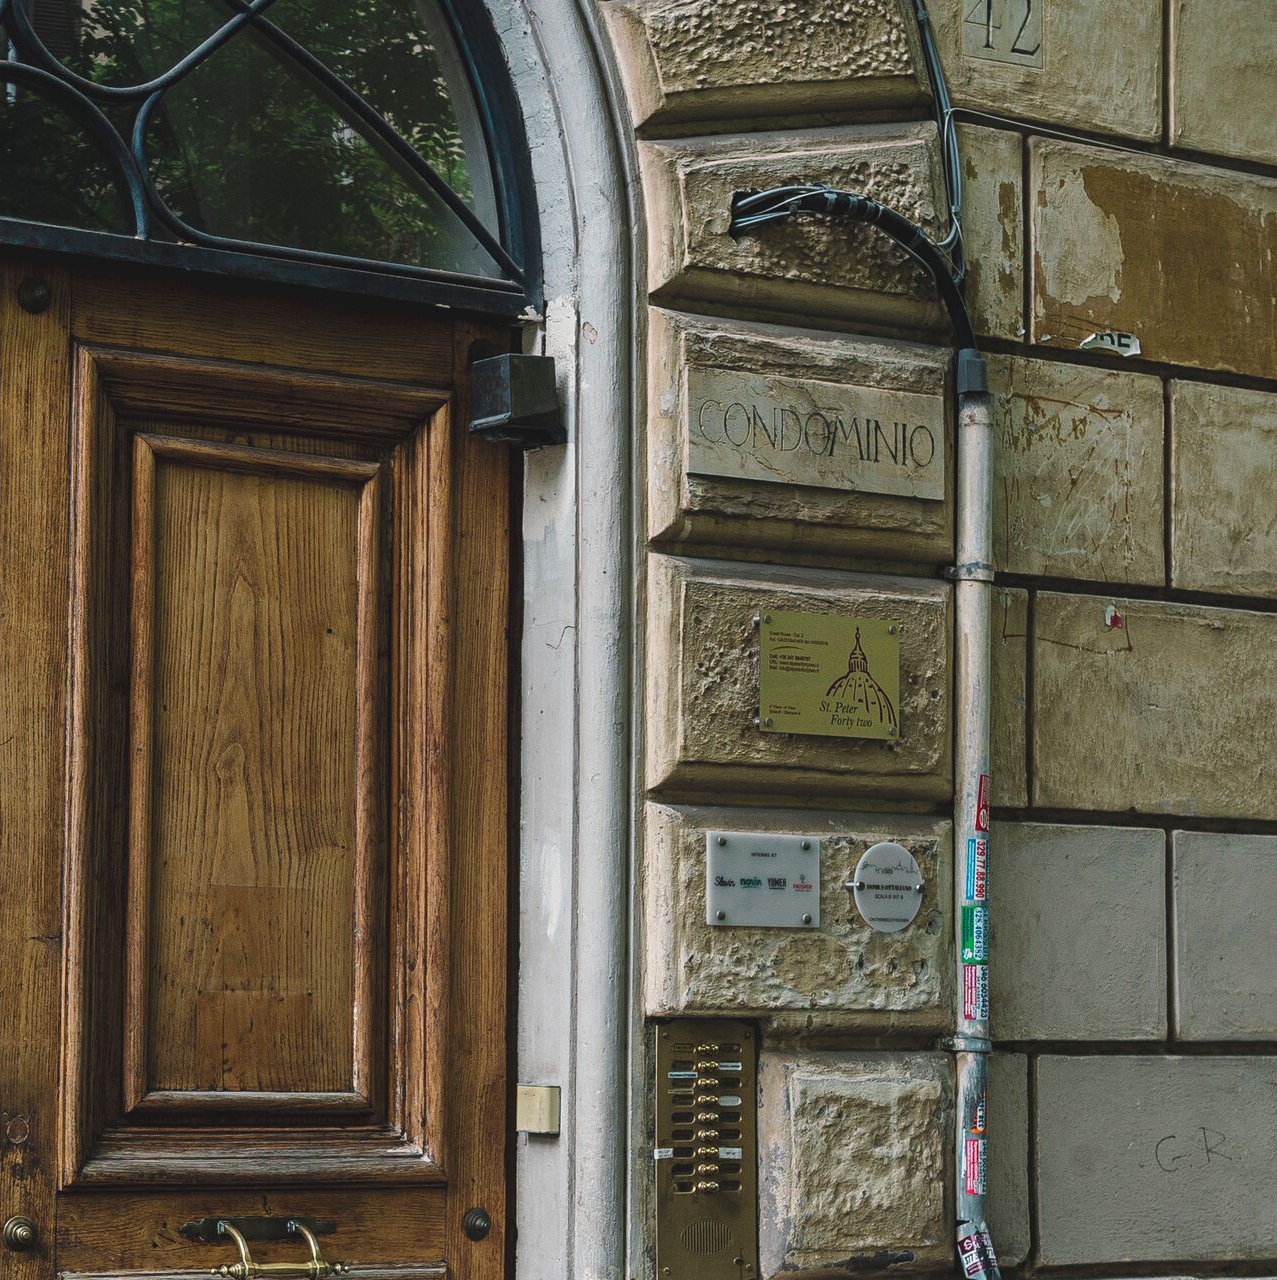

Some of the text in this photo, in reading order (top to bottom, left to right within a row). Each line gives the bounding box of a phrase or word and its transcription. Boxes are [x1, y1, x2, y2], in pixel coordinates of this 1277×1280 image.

[698, 398, 935, 468] CONDOMINIO
[819, 700, 858, 714] St. Peter
[830, 713, 873, 729] Forty two
[975, 841, 986, 898] 329.77.88.990
